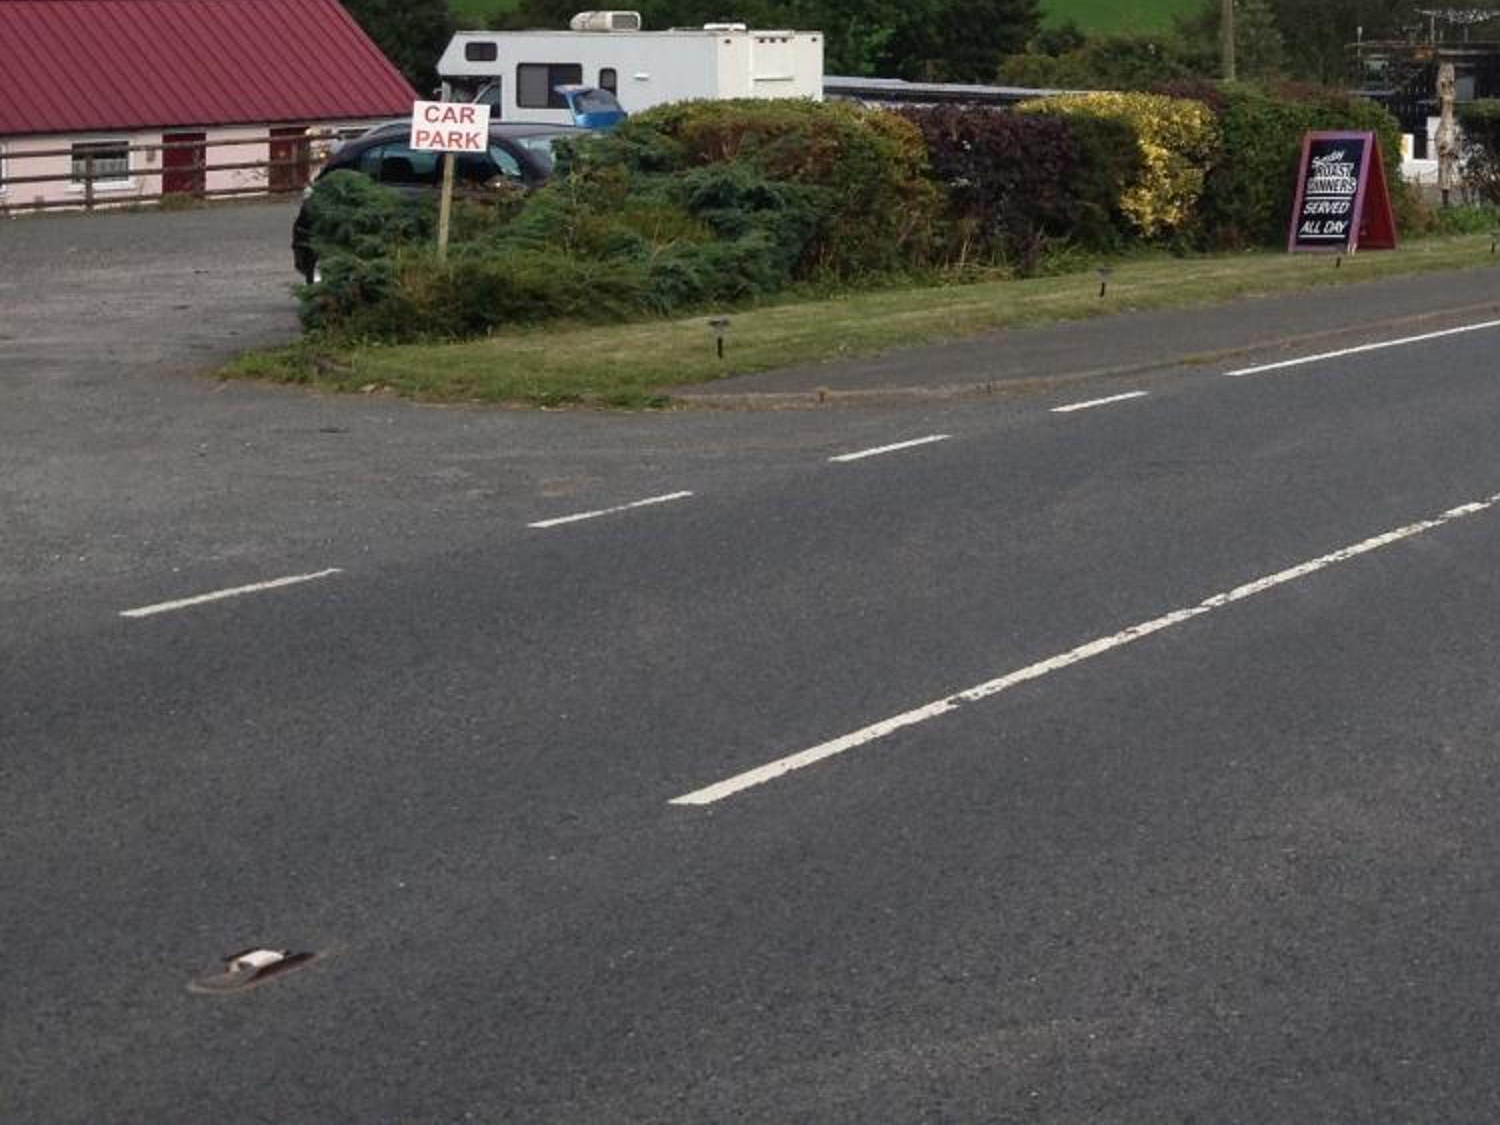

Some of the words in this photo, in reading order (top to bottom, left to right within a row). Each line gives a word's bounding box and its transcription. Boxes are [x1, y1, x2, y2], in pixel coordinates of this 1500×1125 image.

[424, 105, 475, 124] CAR
[415, 130, 481, 149] PARK
[1303, 201, 1351, 215] SERVED
[1299, 221, 1321, 234] ALL
[1323, 220, 1348, 234] DAY
